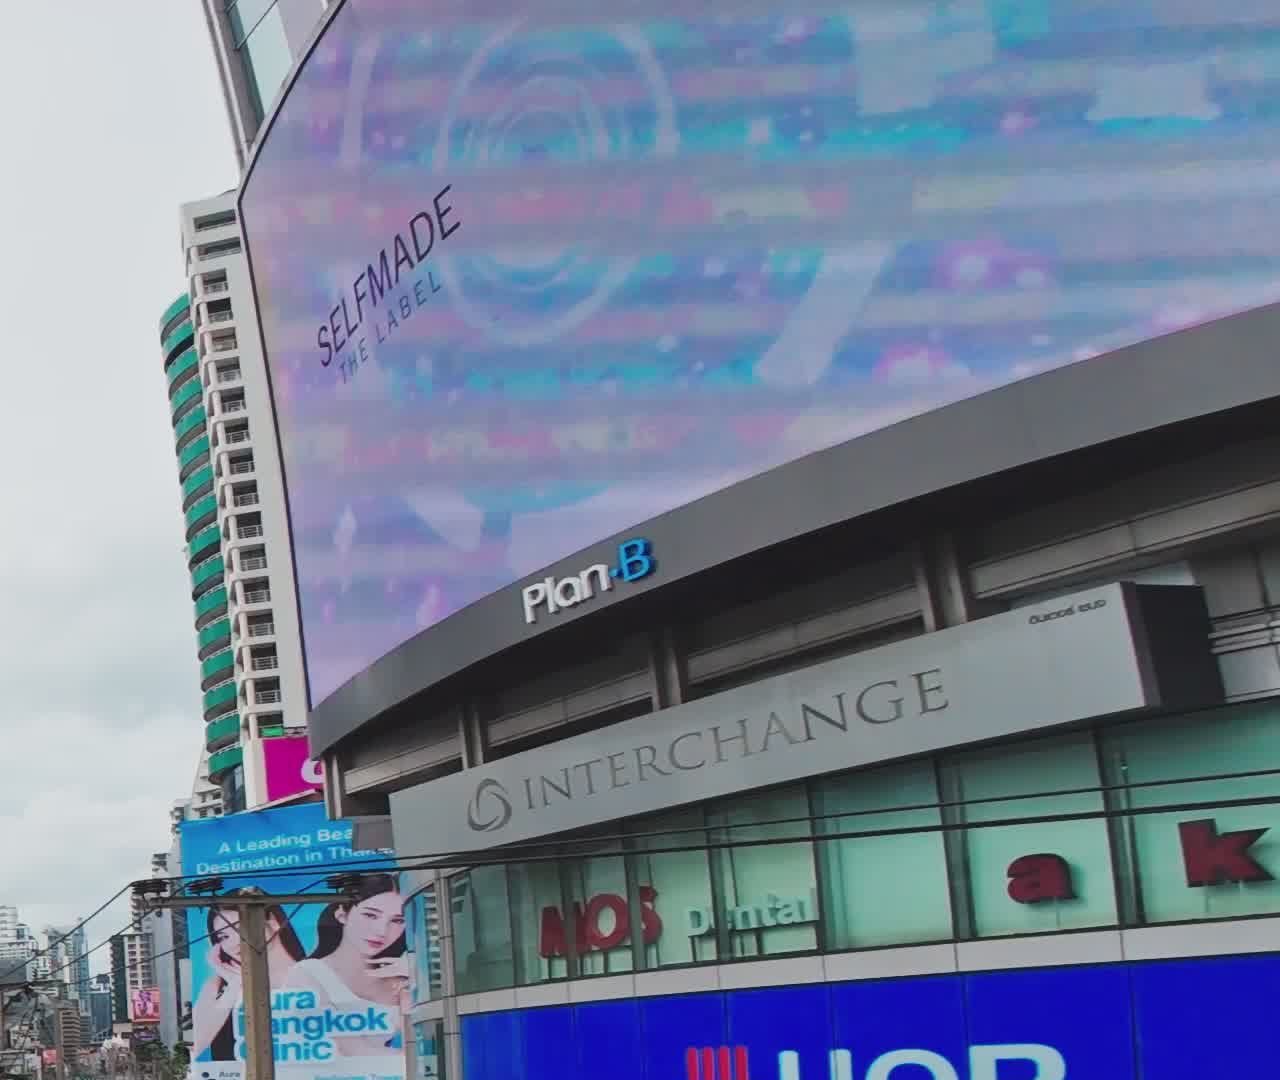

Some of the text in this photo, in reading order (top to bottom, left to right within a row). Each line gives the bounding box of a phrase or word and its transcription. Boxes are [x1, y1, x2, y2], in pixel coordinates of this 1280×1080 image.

[317, 184, 461, 367] SELFMADE
[340, 272, 441, 384] THE LABEL
[524, 667, 950, 811] INTERCHANGE
[196, 850, 299, 875] Destination
[305, 847, 322, 862] in
[218, 827, 353, 855] A Leading Bea
[688, 886, 820, 937] Dntal
